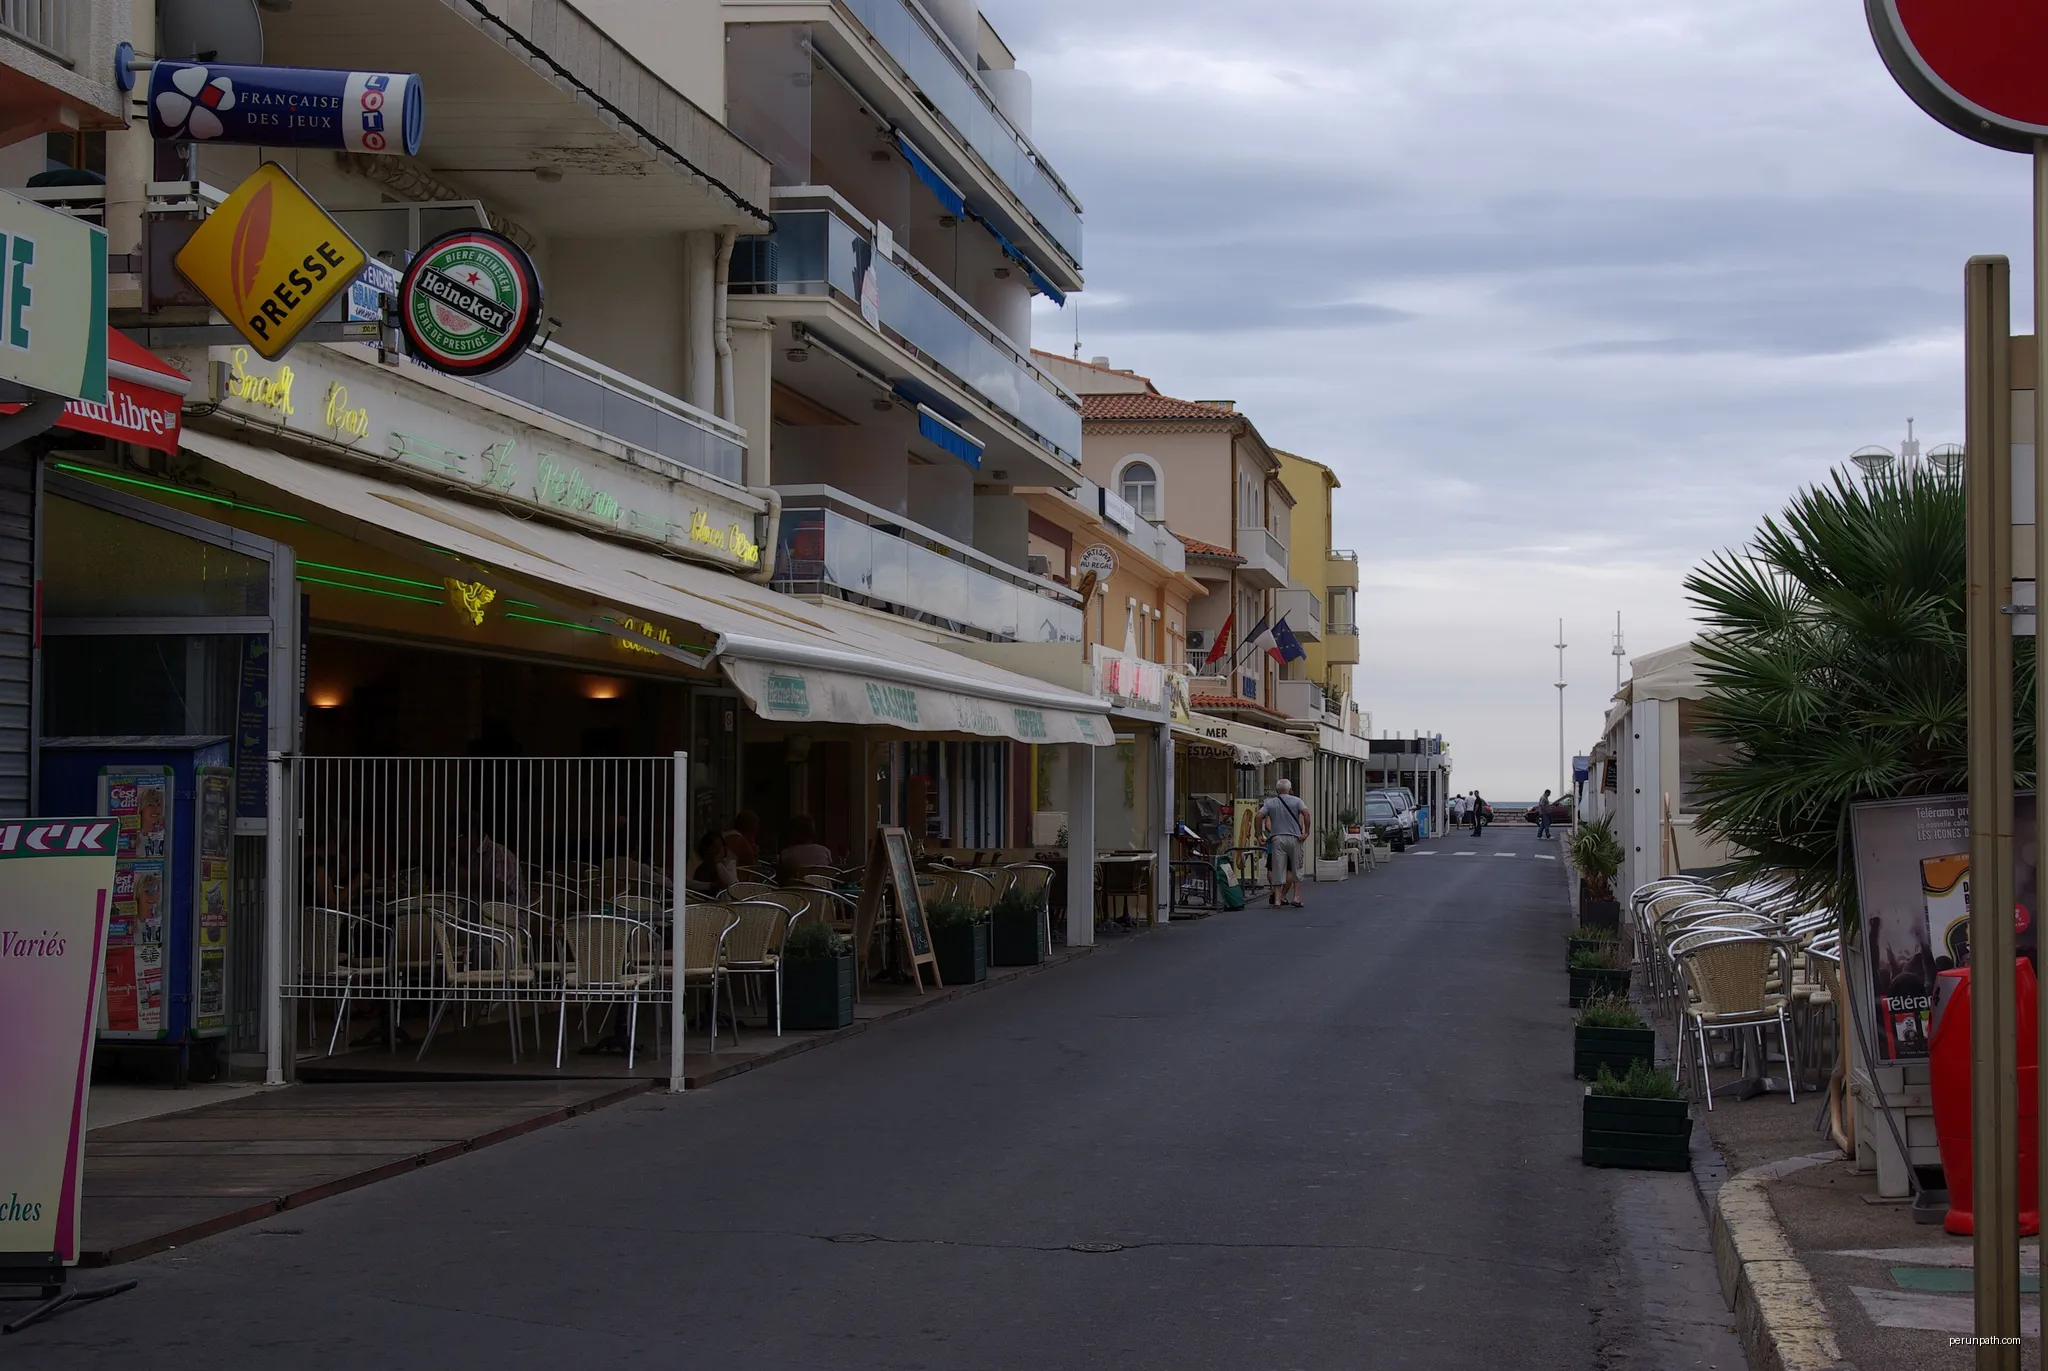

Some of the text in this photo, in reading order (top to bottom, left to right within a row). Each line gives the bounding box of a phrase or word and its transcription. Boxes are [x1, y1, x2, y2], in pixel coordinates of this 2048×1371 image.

[247, 112, 332, 129] DES JEUX
[445, 250, 475, 264] BIERE
[476, 252, 512, 293] HEINEKEN
[0, 232, 34, 349] E
[248, 241, 345, 341] PRESSE
[421, 271, 506, 328] Heineken
[417, 302, 489, 351] BIERE DE PRESTIGE
[230, 348, 370, 438] Snack Bar
[64, 390, 164, 435] Libre
[1083, 548, 1112, 563] ARTISAN
[1206, 728, 1228, 738] MER
[111, 788, 136, 799] C'est
[1916, 806, 1955, 819] Télérama
[1953, 819, 1969, 827] colle
[1917, 830, 1932, 841] LES
[1934, 828, 1962, 840] ICONES
[115, 874, 133, 884] 'est
[2, 930, 67, 957] Variés
[1882, 994, 1933, 1012] Téléra
